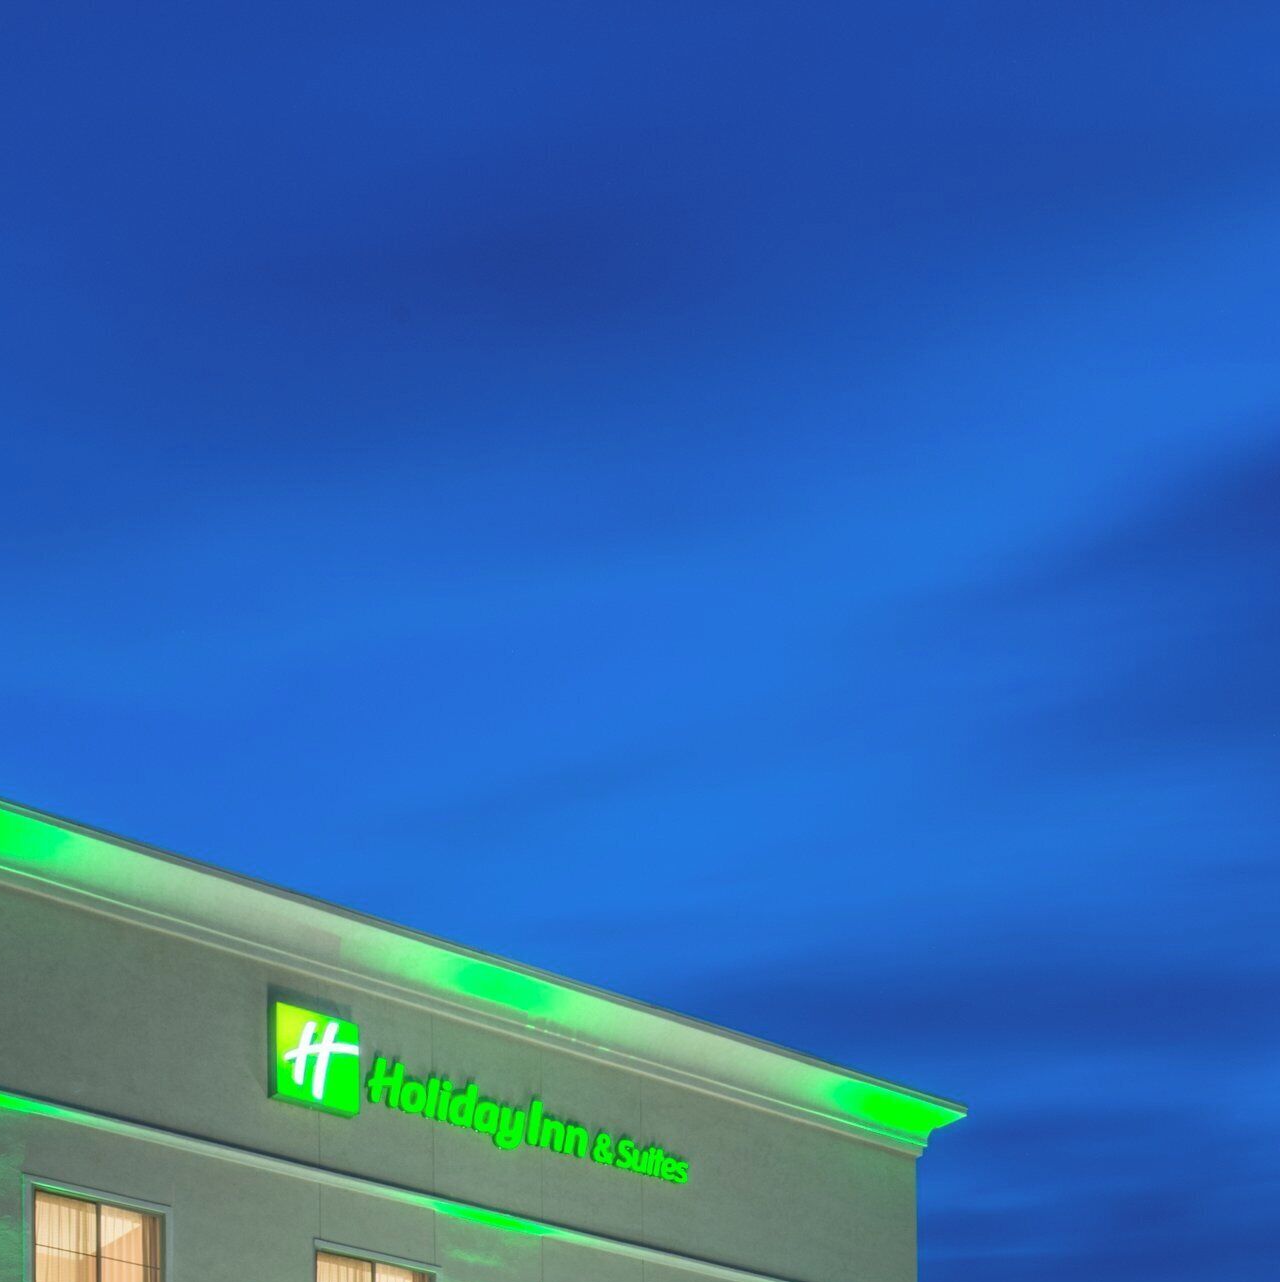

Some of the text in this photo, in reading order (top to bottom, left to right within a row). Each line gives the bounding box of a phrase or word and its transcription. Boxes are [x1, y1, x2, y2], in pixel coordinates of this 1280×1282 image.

[366, 1056, 689, 1184] Holiday Inn & Suites
